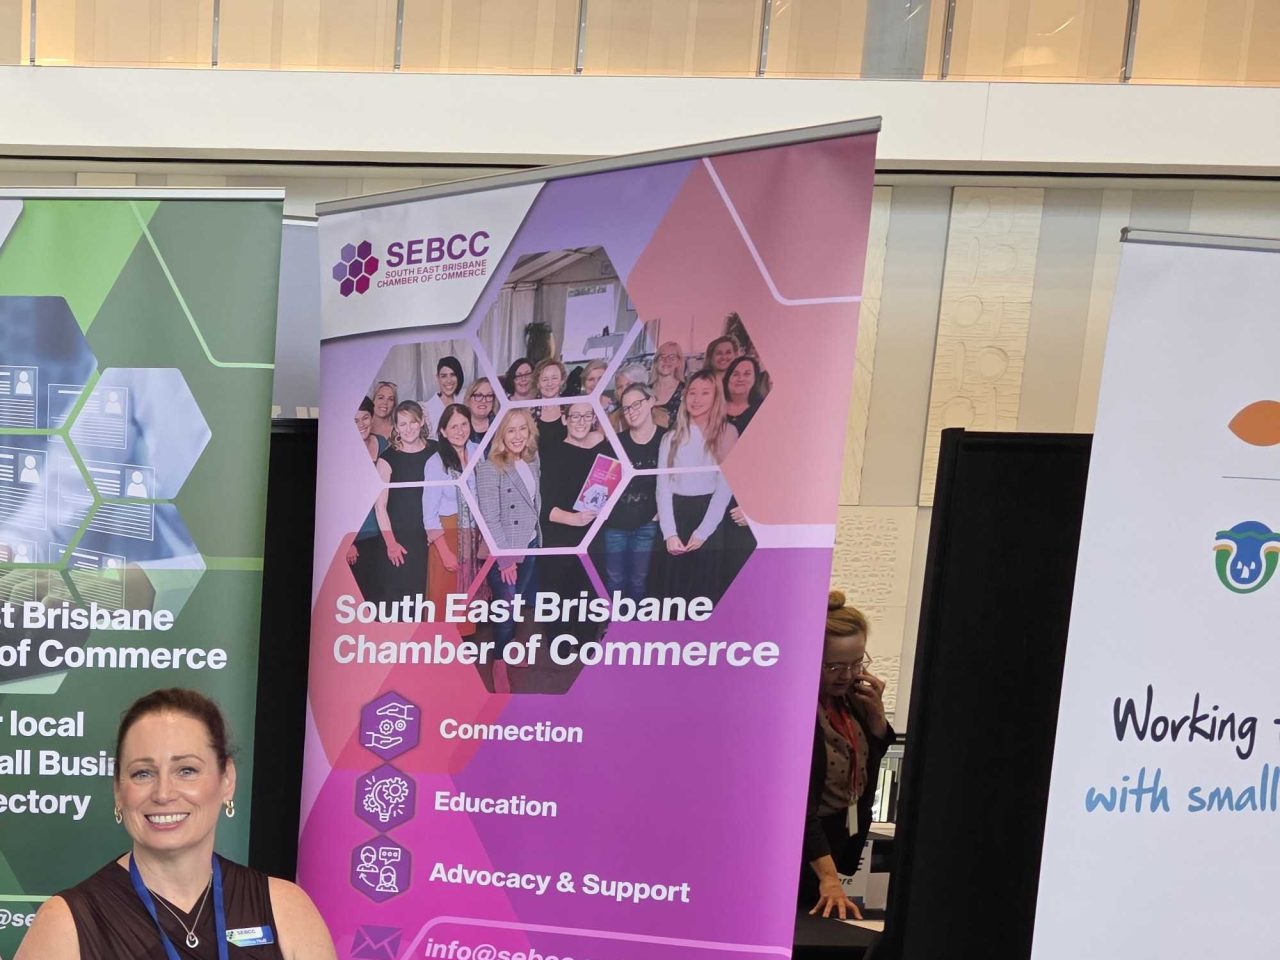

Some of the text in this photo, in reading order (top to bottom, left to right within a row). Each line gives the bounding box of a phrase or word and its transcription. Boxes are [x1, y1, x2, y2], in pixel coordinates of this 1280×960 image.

[386, 230, 490, 268] SEBCC
[377, 268, 487, 288] CHAMBER OF COMMERCE
[385, 259, 487, 279] SOUTH EAST BRISBANE
[23, 601, 174, 632] Brisbane
[334, 589, 714, 623] South East Brisbane
[38, 638, 228, 671] Commerce
[333, 634, 780, 667] Chamber of Commerce
[10, 710, 84, 737] local
[439, 718, 584, 743] Connection
[1113, 684, 1258, 760] Working
[434, 791, 558, 817] Education
[1085, 763, 1280, 813] with small
[429, 861, 691, 904] Advocacy & Support
